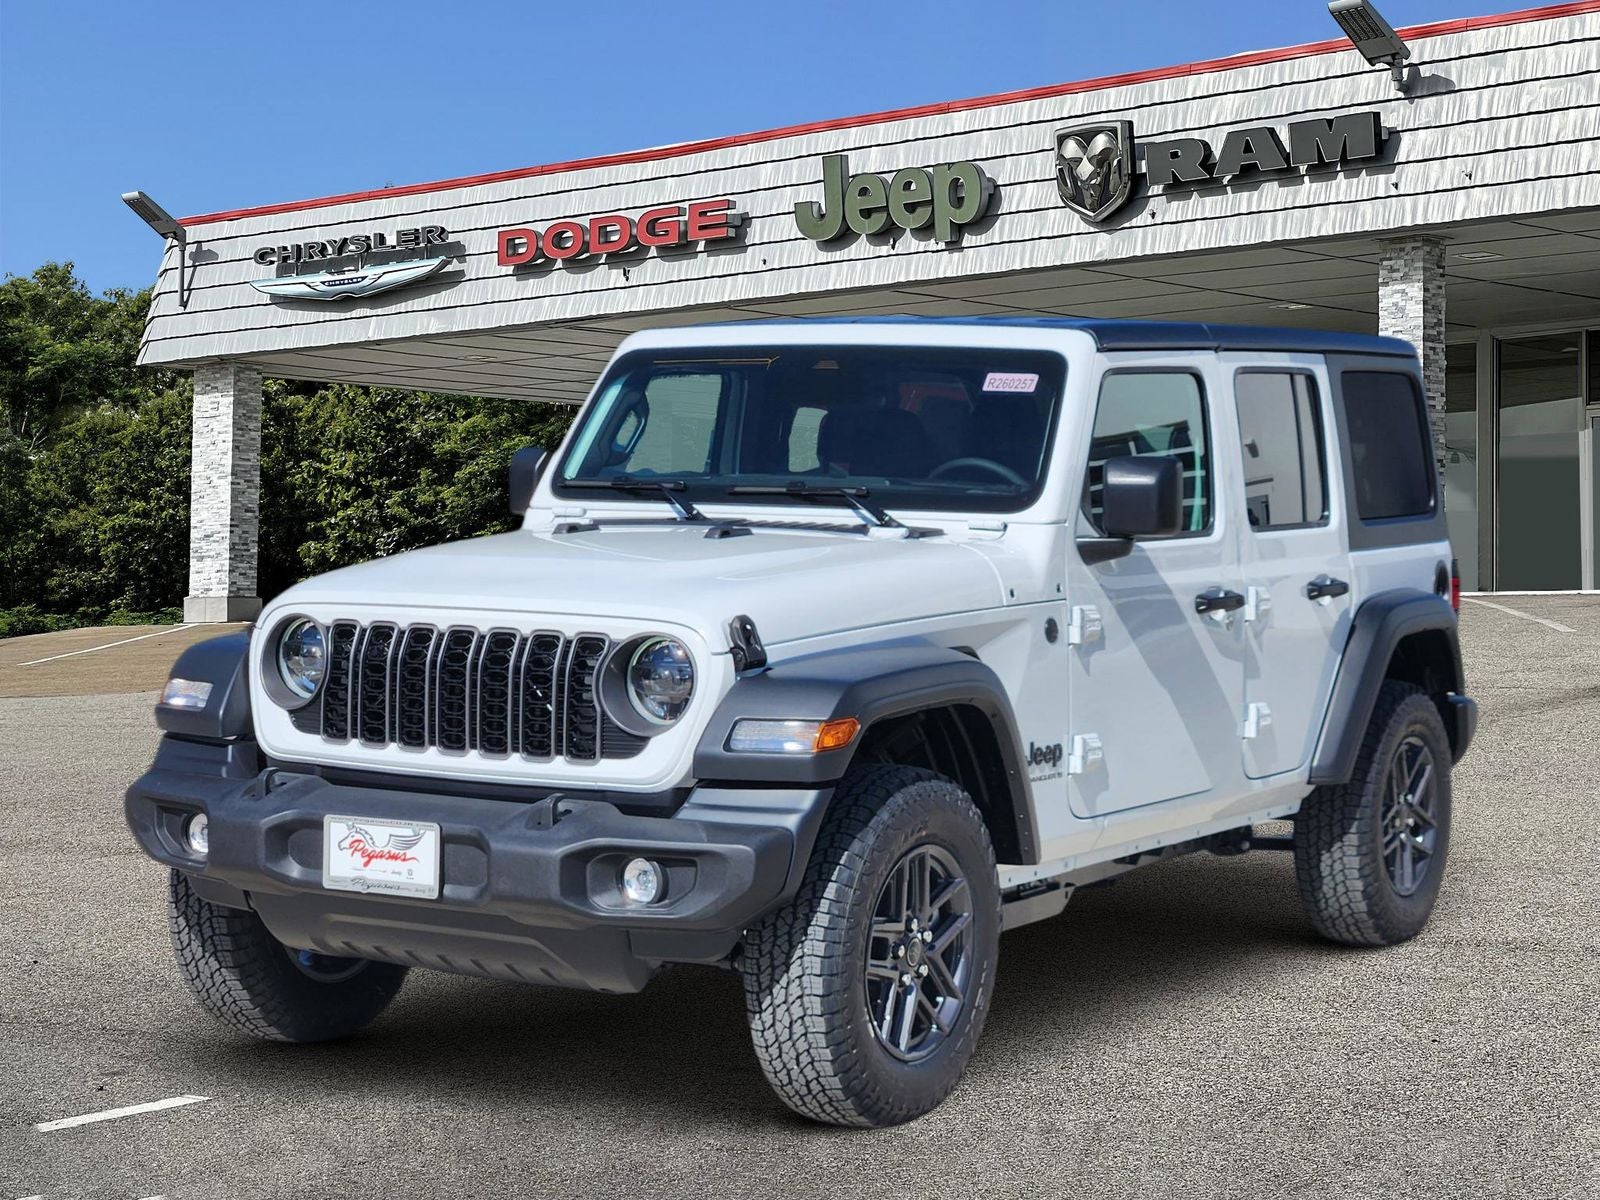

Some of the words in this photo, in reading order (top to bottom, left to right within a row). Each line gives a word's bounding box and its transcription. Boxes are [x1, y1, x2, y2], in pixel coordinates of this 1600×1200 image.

[1144, 111, 1380, 187] RAM
[794, 154, 985, 242] Jeep
[253, 225, 447, 266] CHRYSLER
[497, 199, 736, 266] DODGE
[987, 377, 1034, 389] R260257
[1025, 741, 1063, 767] Jeep
[349, 838, 420, 868] Pegasus
